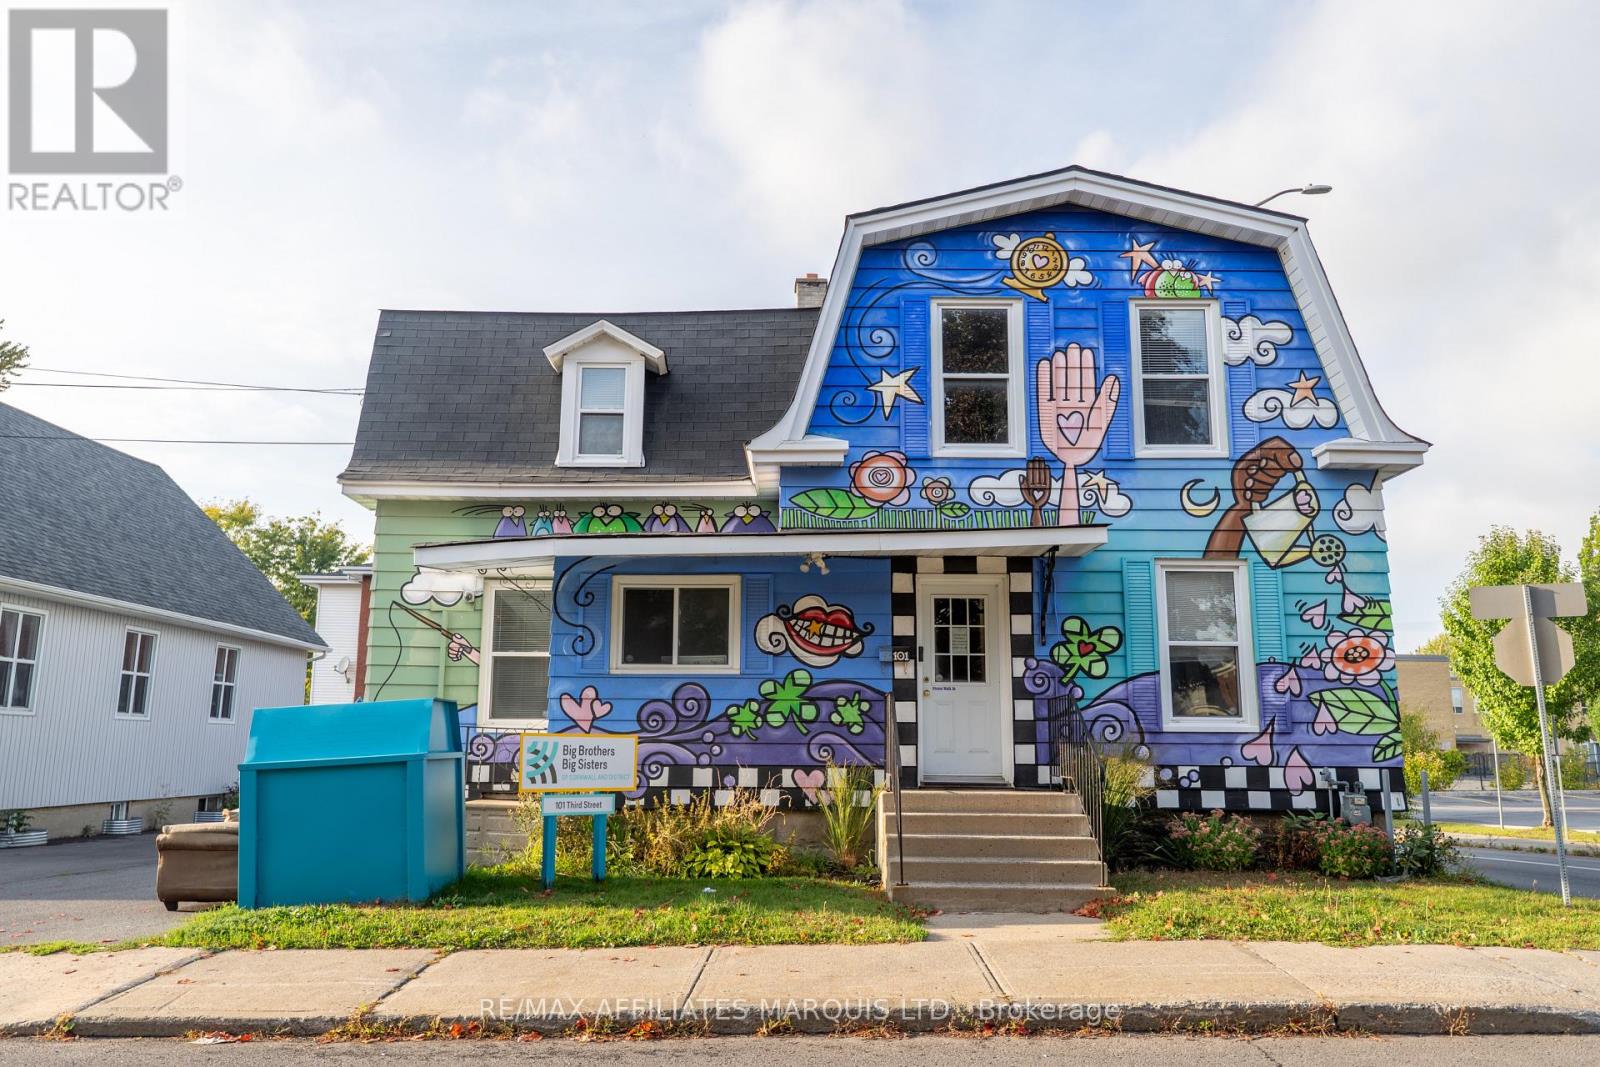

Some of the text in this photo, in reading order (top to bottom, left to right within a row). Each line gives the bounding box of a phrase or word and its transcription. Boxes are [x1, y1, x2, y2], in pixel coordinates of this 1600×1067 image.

[893, 651, 909, 661] 101
[562, 744, 615, 759] Big Brothers
[562, 758, 608, 772] Big Sisters
[555, 801, 602, 809] 101 Third Street
